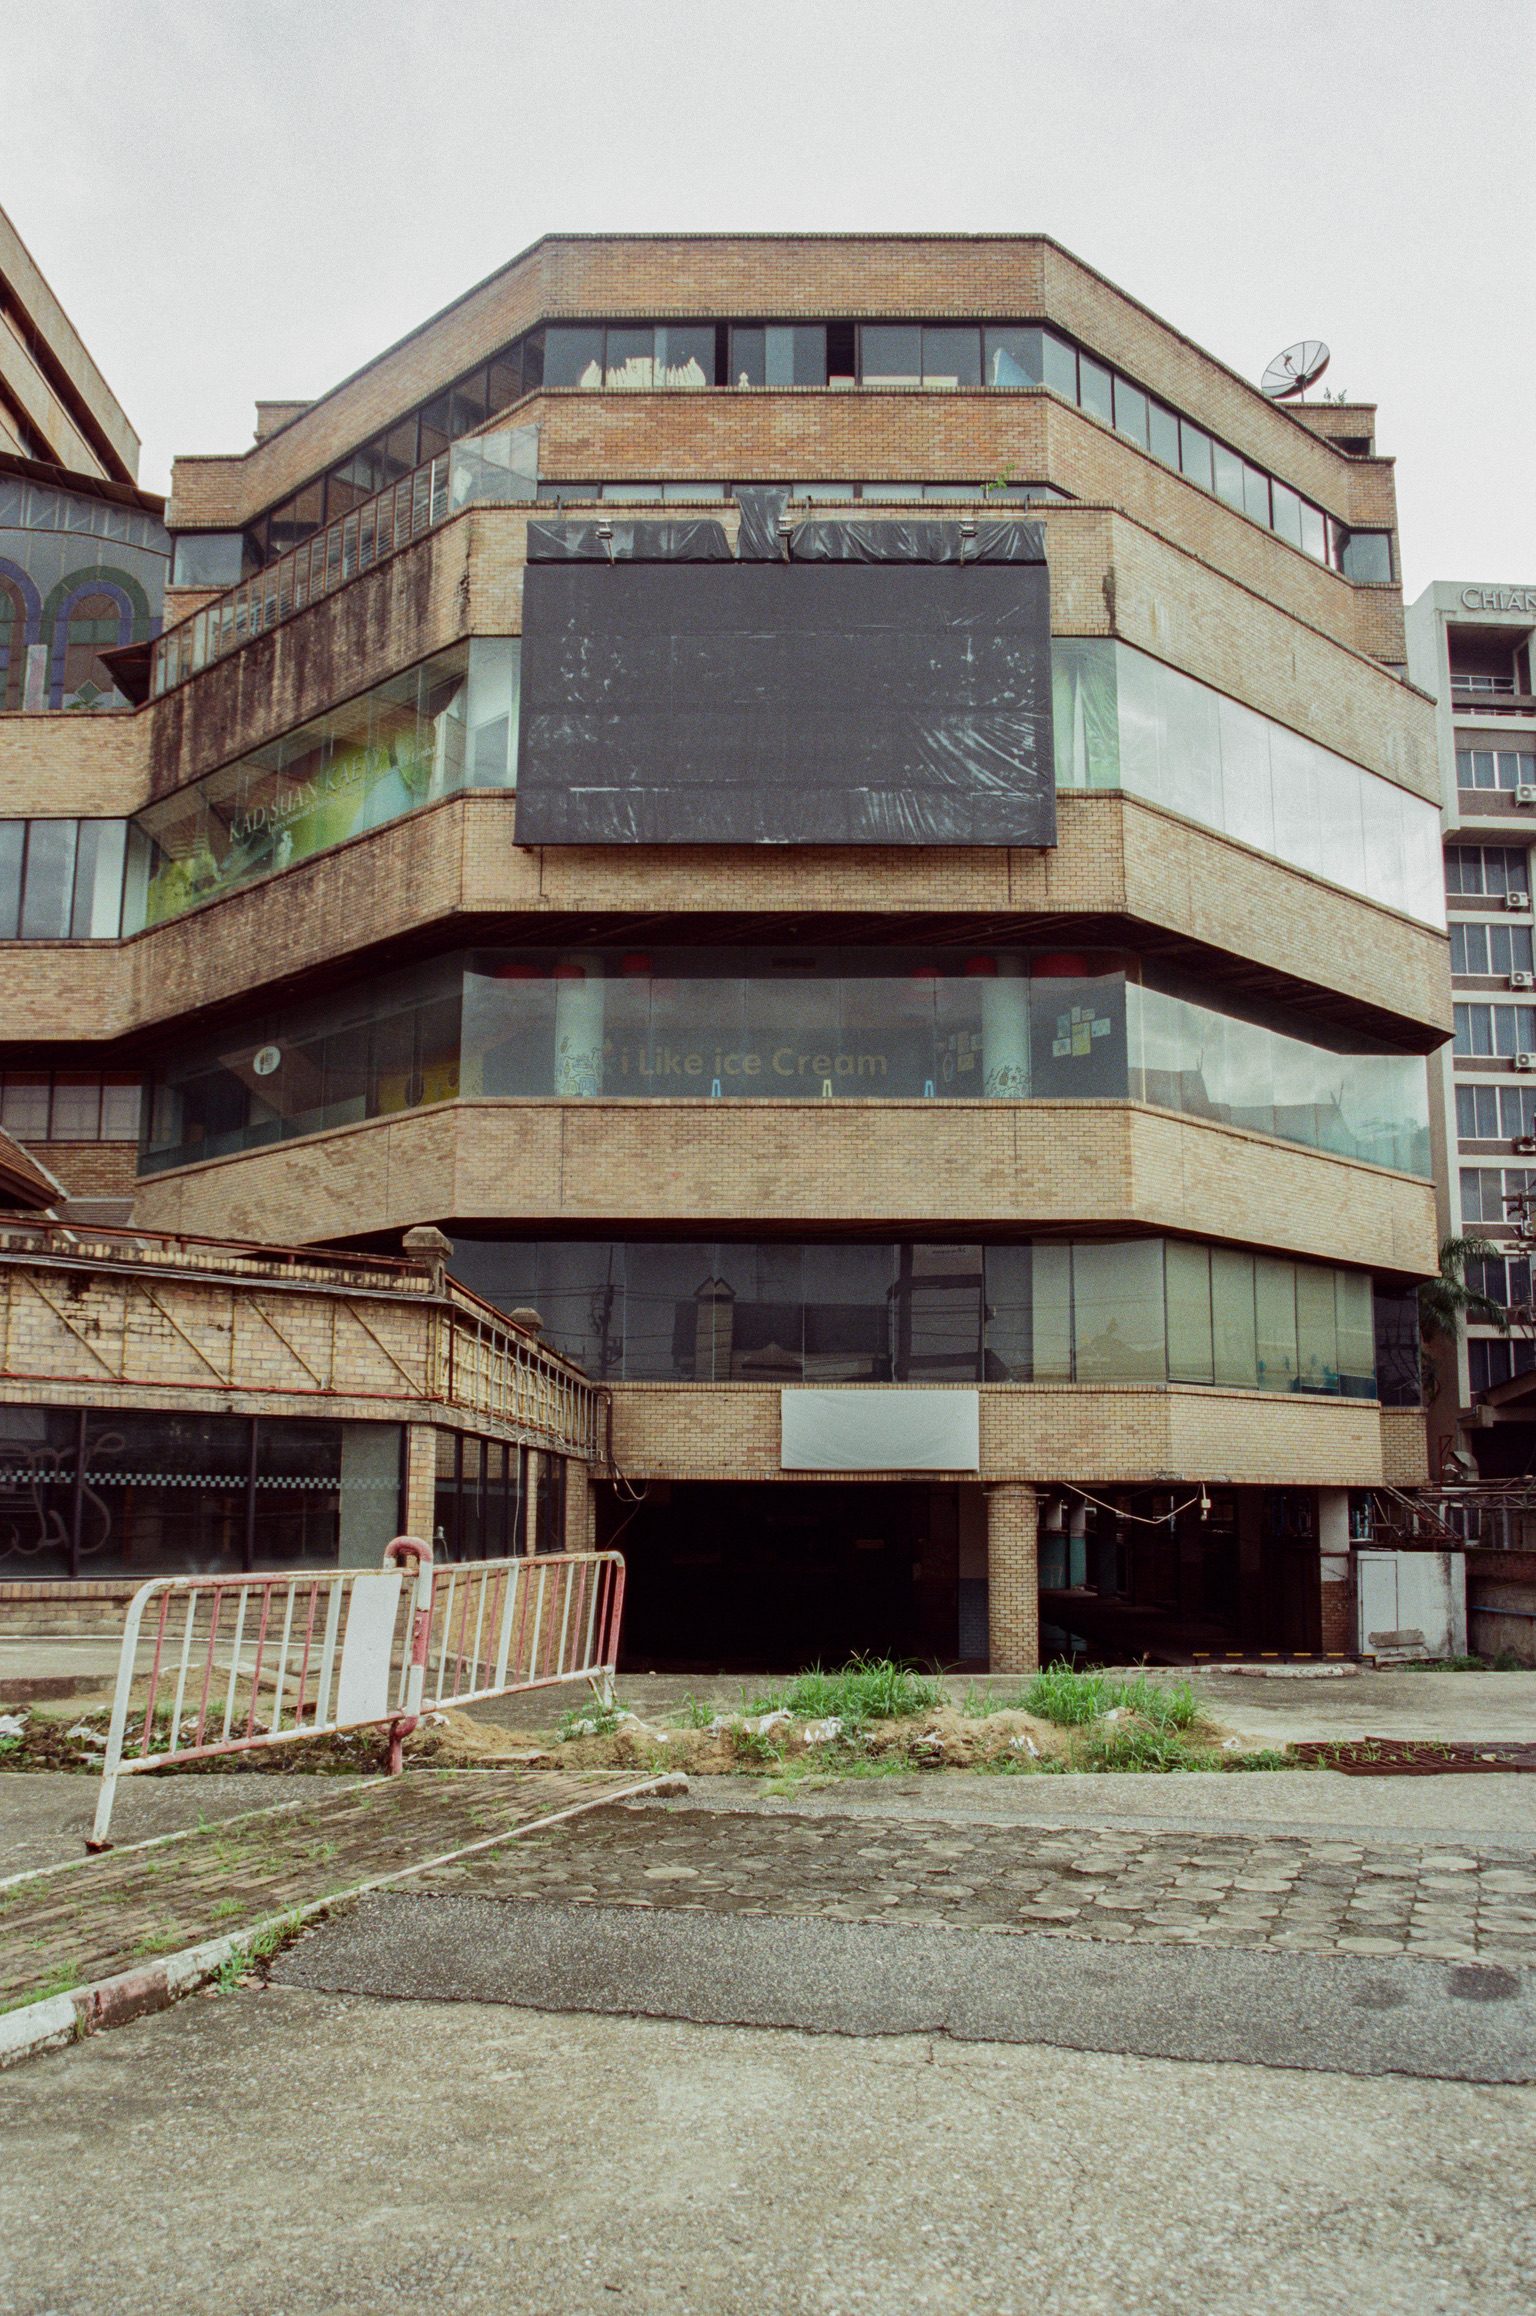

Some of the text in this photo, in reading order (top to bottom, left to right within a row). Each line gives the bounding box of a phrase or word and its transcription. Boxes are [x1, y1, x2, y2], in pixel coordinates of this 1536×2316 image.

[229, 806, 265, 842] KAD
[270, 778, 320, 821] SUAN
[638, 1046, 702, 1076] Like
[714, 1047, 762, 1076] ice
[772, 1047, 887, 1077] Cream
